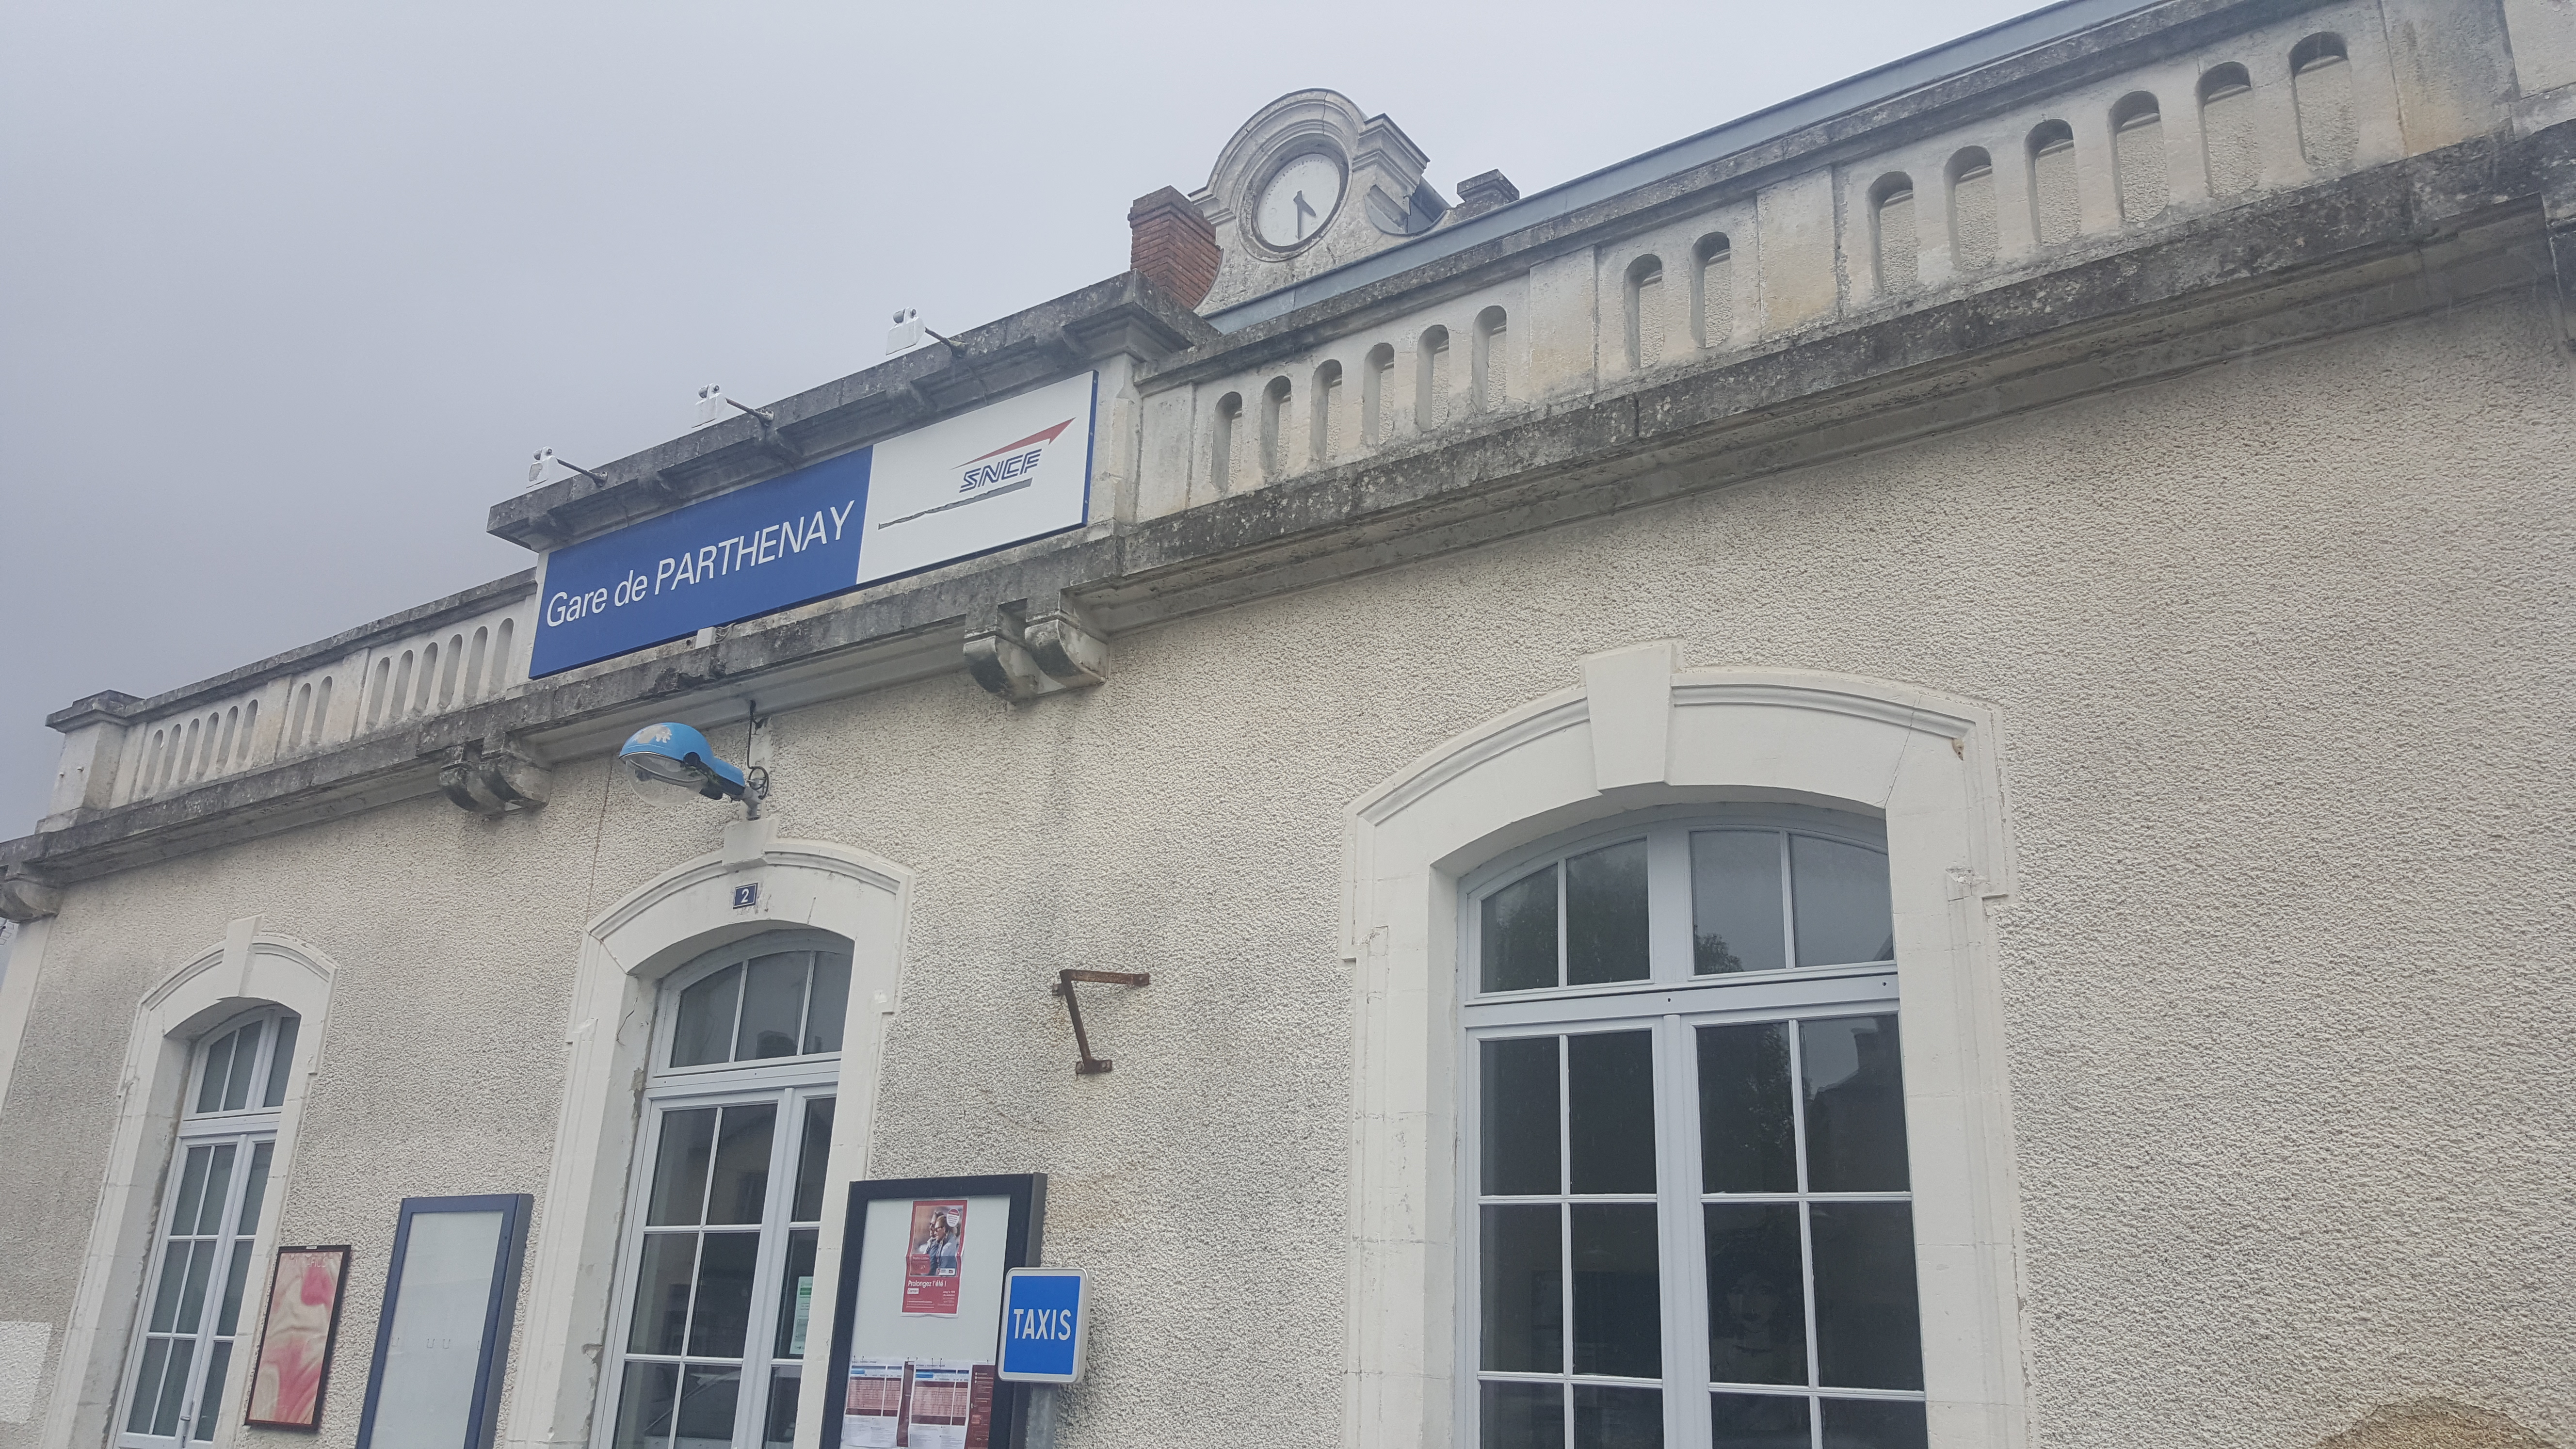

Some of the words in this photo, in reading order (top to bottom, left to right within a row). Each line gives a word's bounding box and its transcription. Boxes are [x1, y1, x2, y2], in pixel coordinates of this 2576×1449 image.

[959, 449, 1042, 493] SNCF
[547, 588, 607, 627] Gare
[614, 570, 647, 607] de
[655, 499, 855, 595] PARTHENAY
[741, 888, 750, 903] 2
[908, 1280, 932, 1288] Prolongez
[1014, 1309, 1071, 1340] TAXIS
